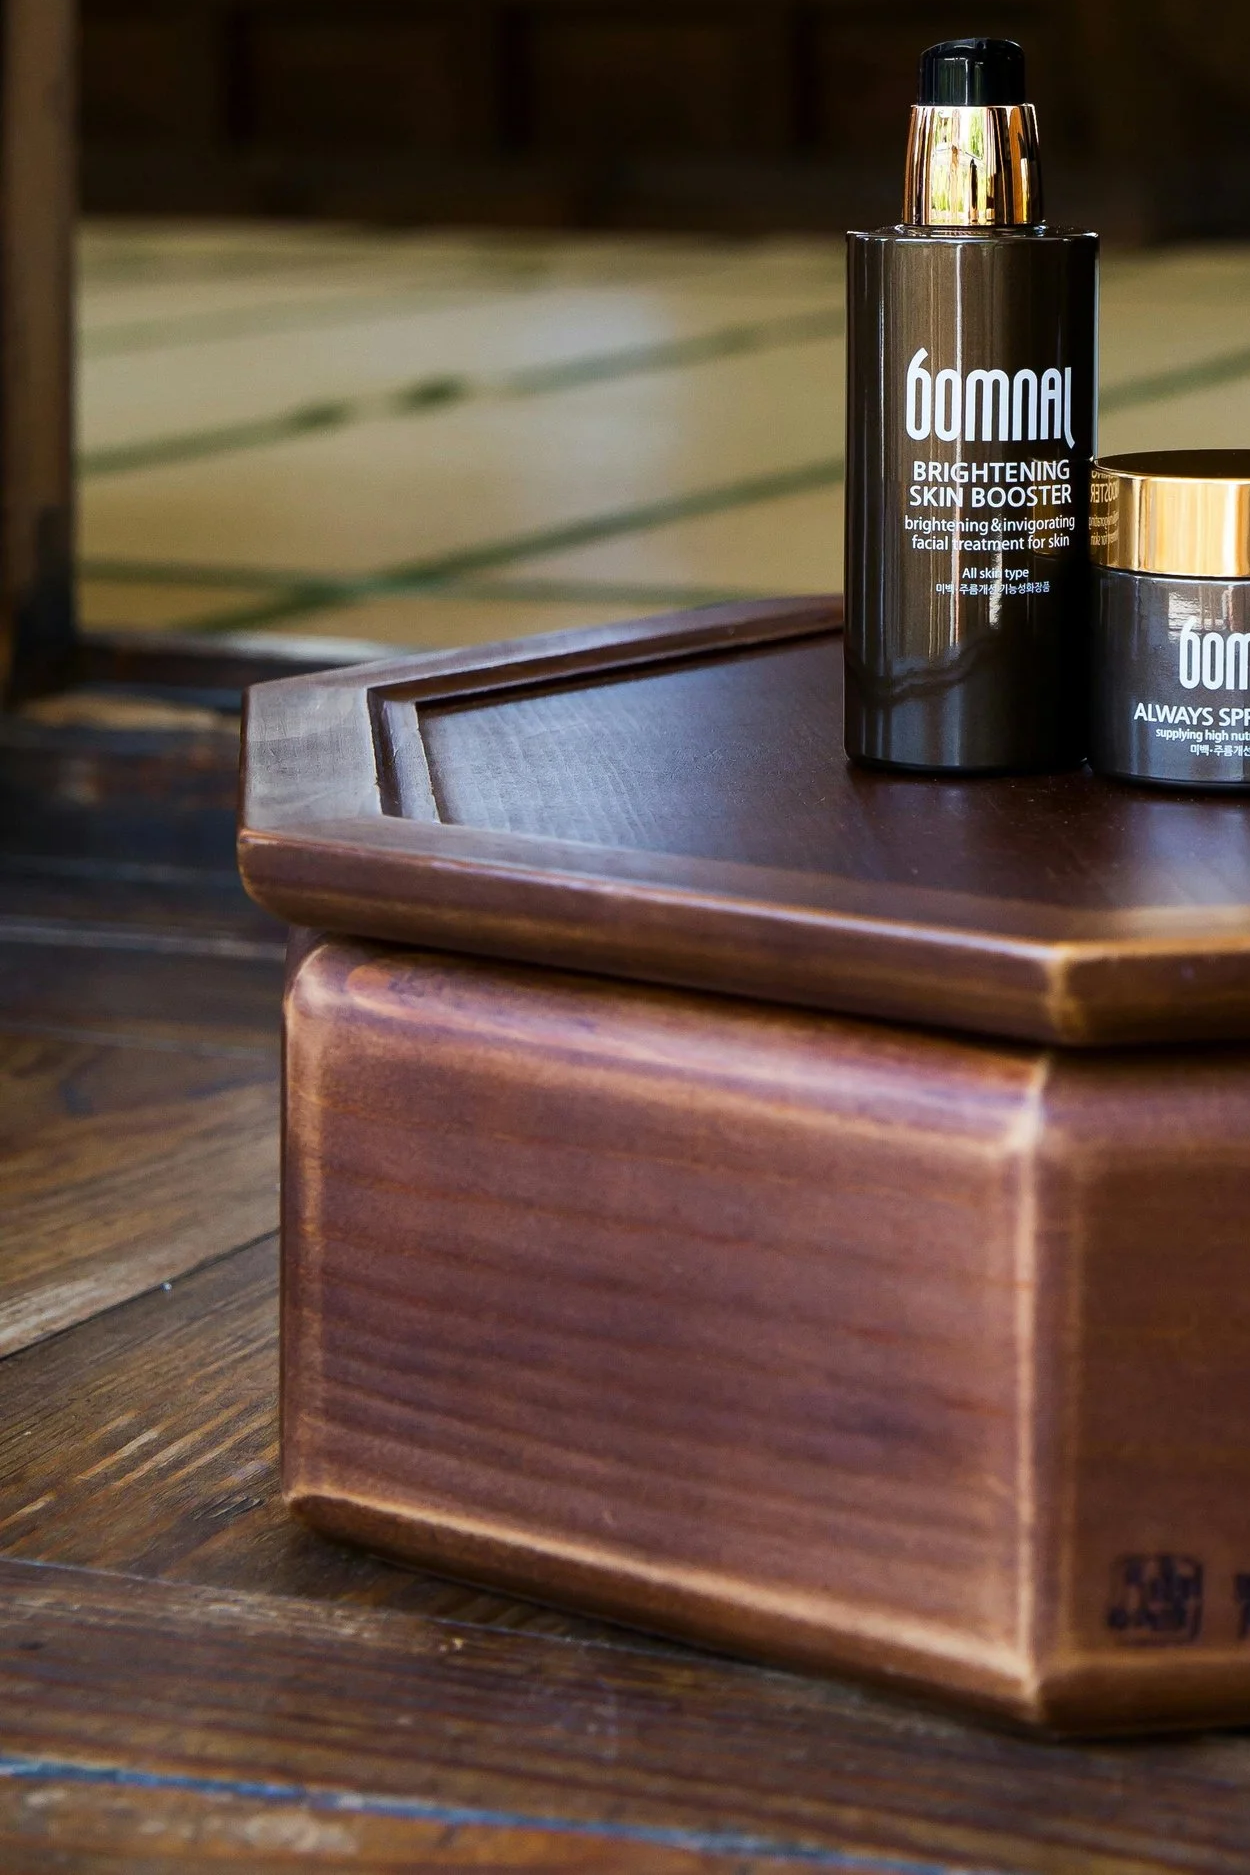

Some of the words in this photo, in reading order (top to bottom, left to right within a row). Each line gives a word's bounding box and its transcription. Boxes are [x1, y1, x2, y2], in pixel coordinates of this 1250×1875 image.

[913, 459, 1070, 483] BRIGHTENING
[910, 486, 963, 507] SKIN
[971, 484, 1072, 508] BOOSTER
[905, 515, 988, 535] brightening
[991, 520, 1002, 533] &
[1003, 515, 1075, 533] invigorating
[912, 535, 948, 550] facial
[952, 536, 1024, 551] treatment
[1027, 534, 1046, 550] for
[1048, 533, 1070, 547] skin
[962, 567, 977, 579] All
[980, 567, 1001, 579] skin
[1005, 568, 1029, 580] type
[999, 581, 1050, 594] 기능성화장품
[1134, 703, 1213, 725] ALWAYS
[1155, 728, 1202, 742] supplying
[1205, 729, 1229, 743] high
